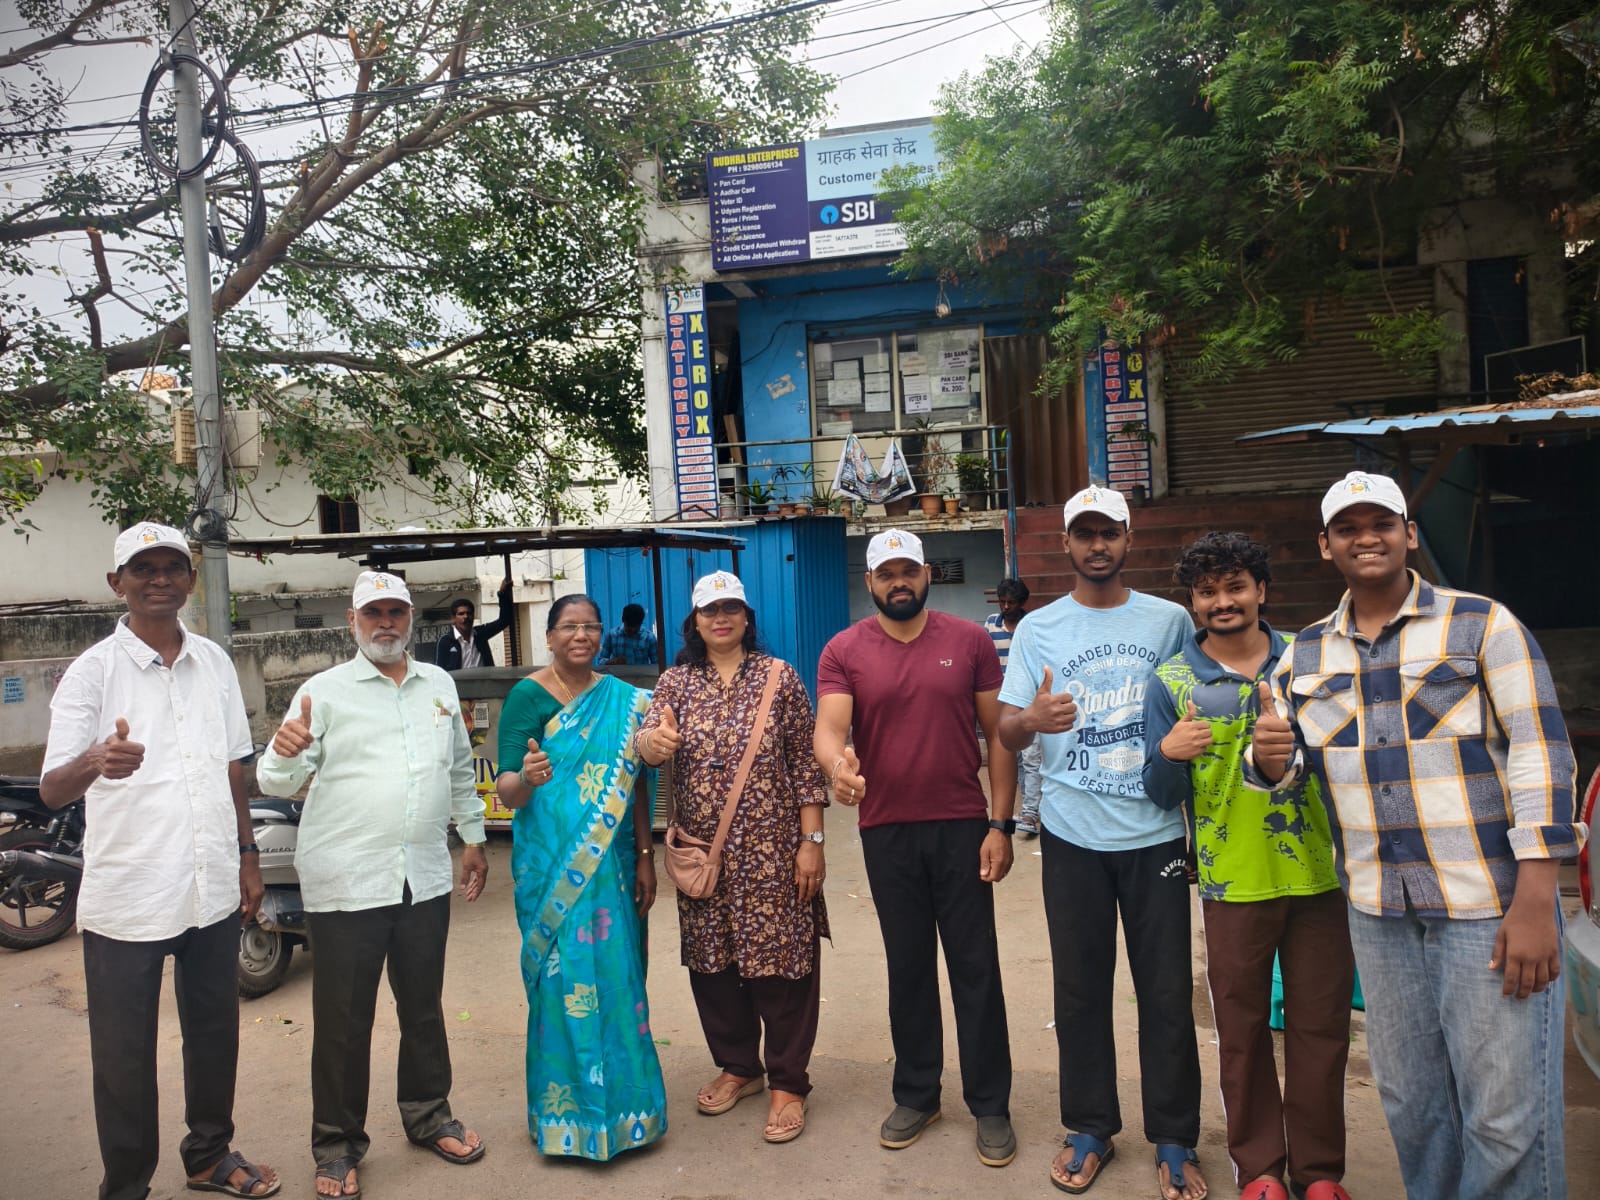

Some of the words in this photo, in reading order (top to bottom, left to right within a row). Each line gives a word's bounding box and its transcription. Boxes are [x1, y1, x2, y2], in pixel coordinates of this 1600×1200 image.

[747, 148, 799, 163] ENTERPRISES
[817, 148, 857, 165] ग्राहक
[861, 141, 888, 159] सेवा
[892, 137, 917, 154] केंद्र
[732, 178, 746, 186] Card
[819, 171, 877, 186] Customer
[720, 188, 740, 196] Aadhar
[741, 186, 755, 194] Card
[720, 198, 735, 206] Voter
[741, 203, 776, 213] Registration
[841, 200, 876, 223] SBI
[741, 243, 755, 251] Card
[756, 241, 778, 249] Amount
[779, 239, 806, 247] Withdraw
[732, 253, 751, 261] Online
[764, 250, 799, 259] Applications
[669, 314, 691, 437] STATIONERY
[689, 313, 710, 435] XEROX
[1061, 644, 1112, 679] GRADED
[1117, 643, 1161, 669] GOODS
[1085, 658, 1114, 677] DENIM
[1116, 657, 1143, 670] DEPT
[1086, 724, 1145, 746] SANFORIZE
[1066, 750, 1089, 771] 20
[1079, 775, 1113, 793] BEST
[1118, 780, 1145, 796] CHO
